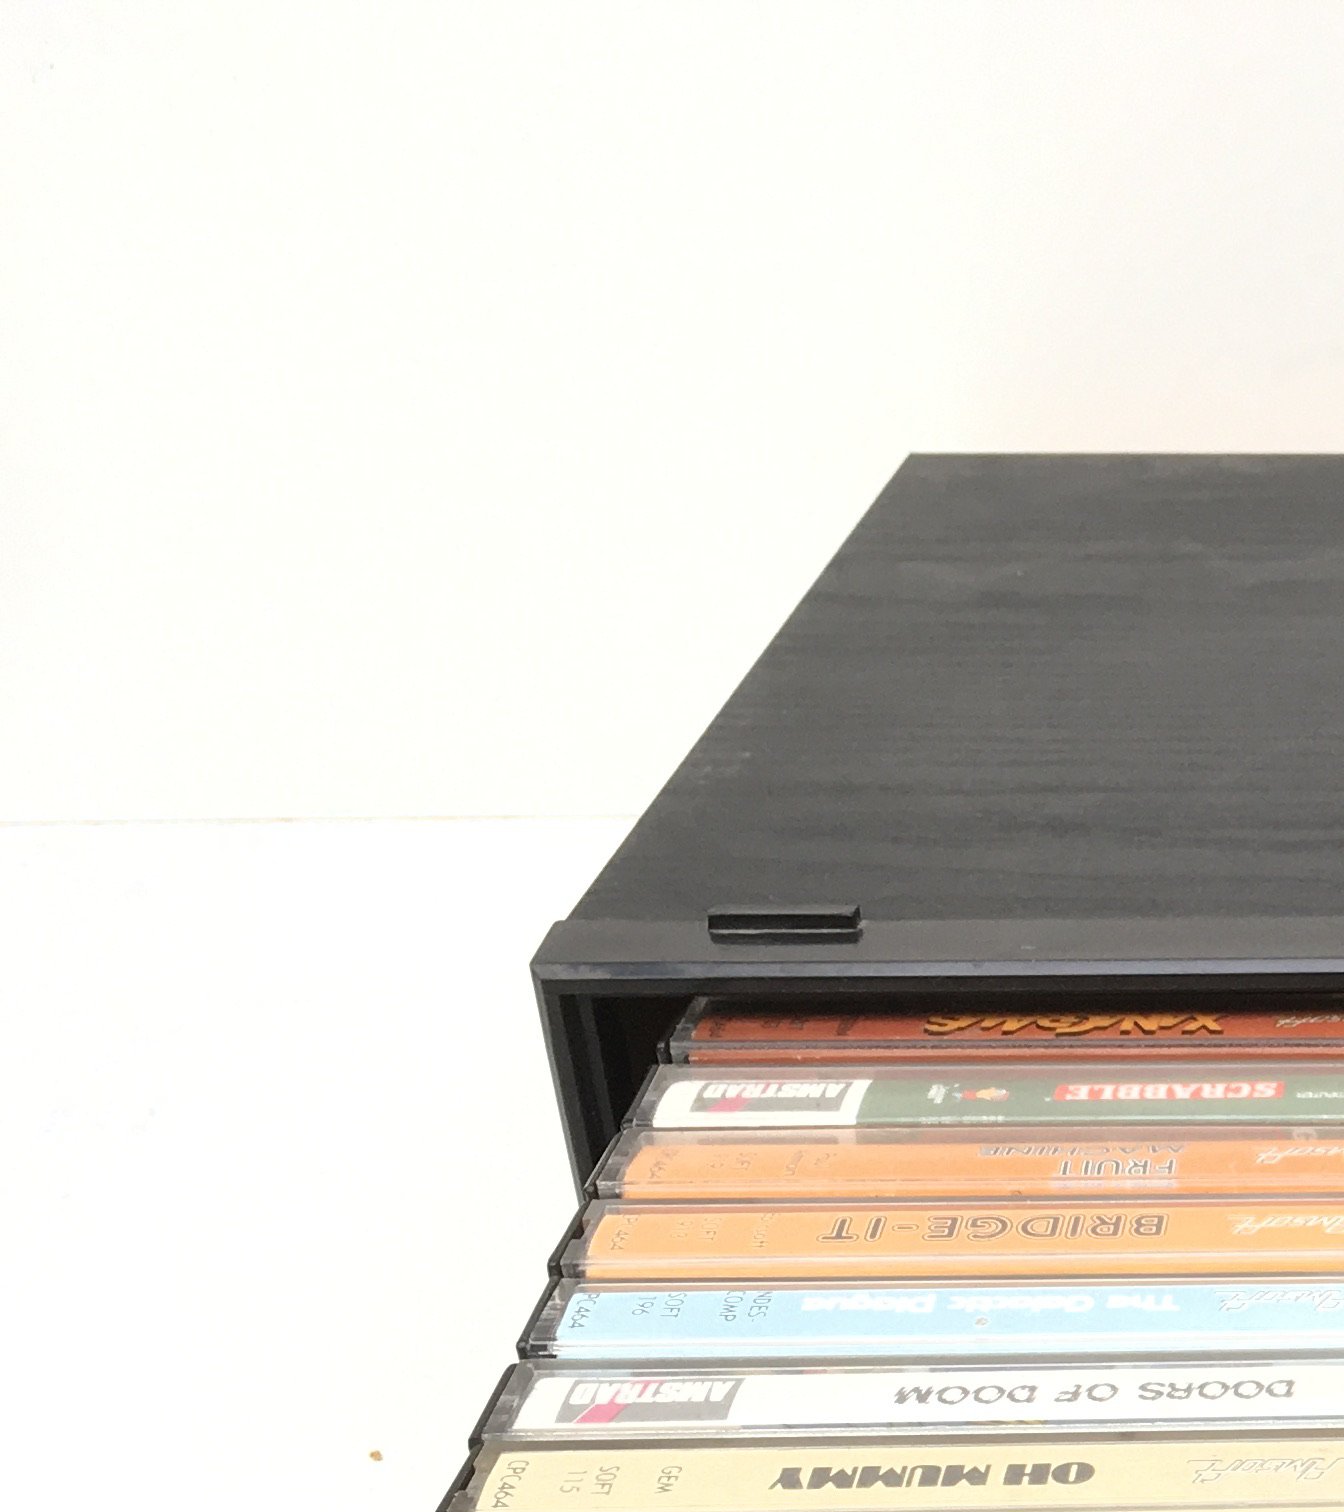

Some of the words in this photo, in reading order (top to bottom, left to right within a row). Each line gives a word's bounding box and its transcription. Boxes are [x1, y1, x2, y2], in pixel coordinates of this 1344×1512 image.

[699, 1080, 847, 1100] AMSTRAD
[1066, 1081, 1278, 1100] SCRABBLE
[816, 1214, 1169, 1243] BRIDGE-IT
[562, 1378, 736, 1404] AMSTRAD
[894, 1383, 1037, 1407] DOOM
[1056, 1380, 1120, 1403] OF
[1138, 1378, 1296, 1403] DOORS
[769, 1462, 991, 1490] MUMMY
[1000, 1460, 1096, 1486] OH
